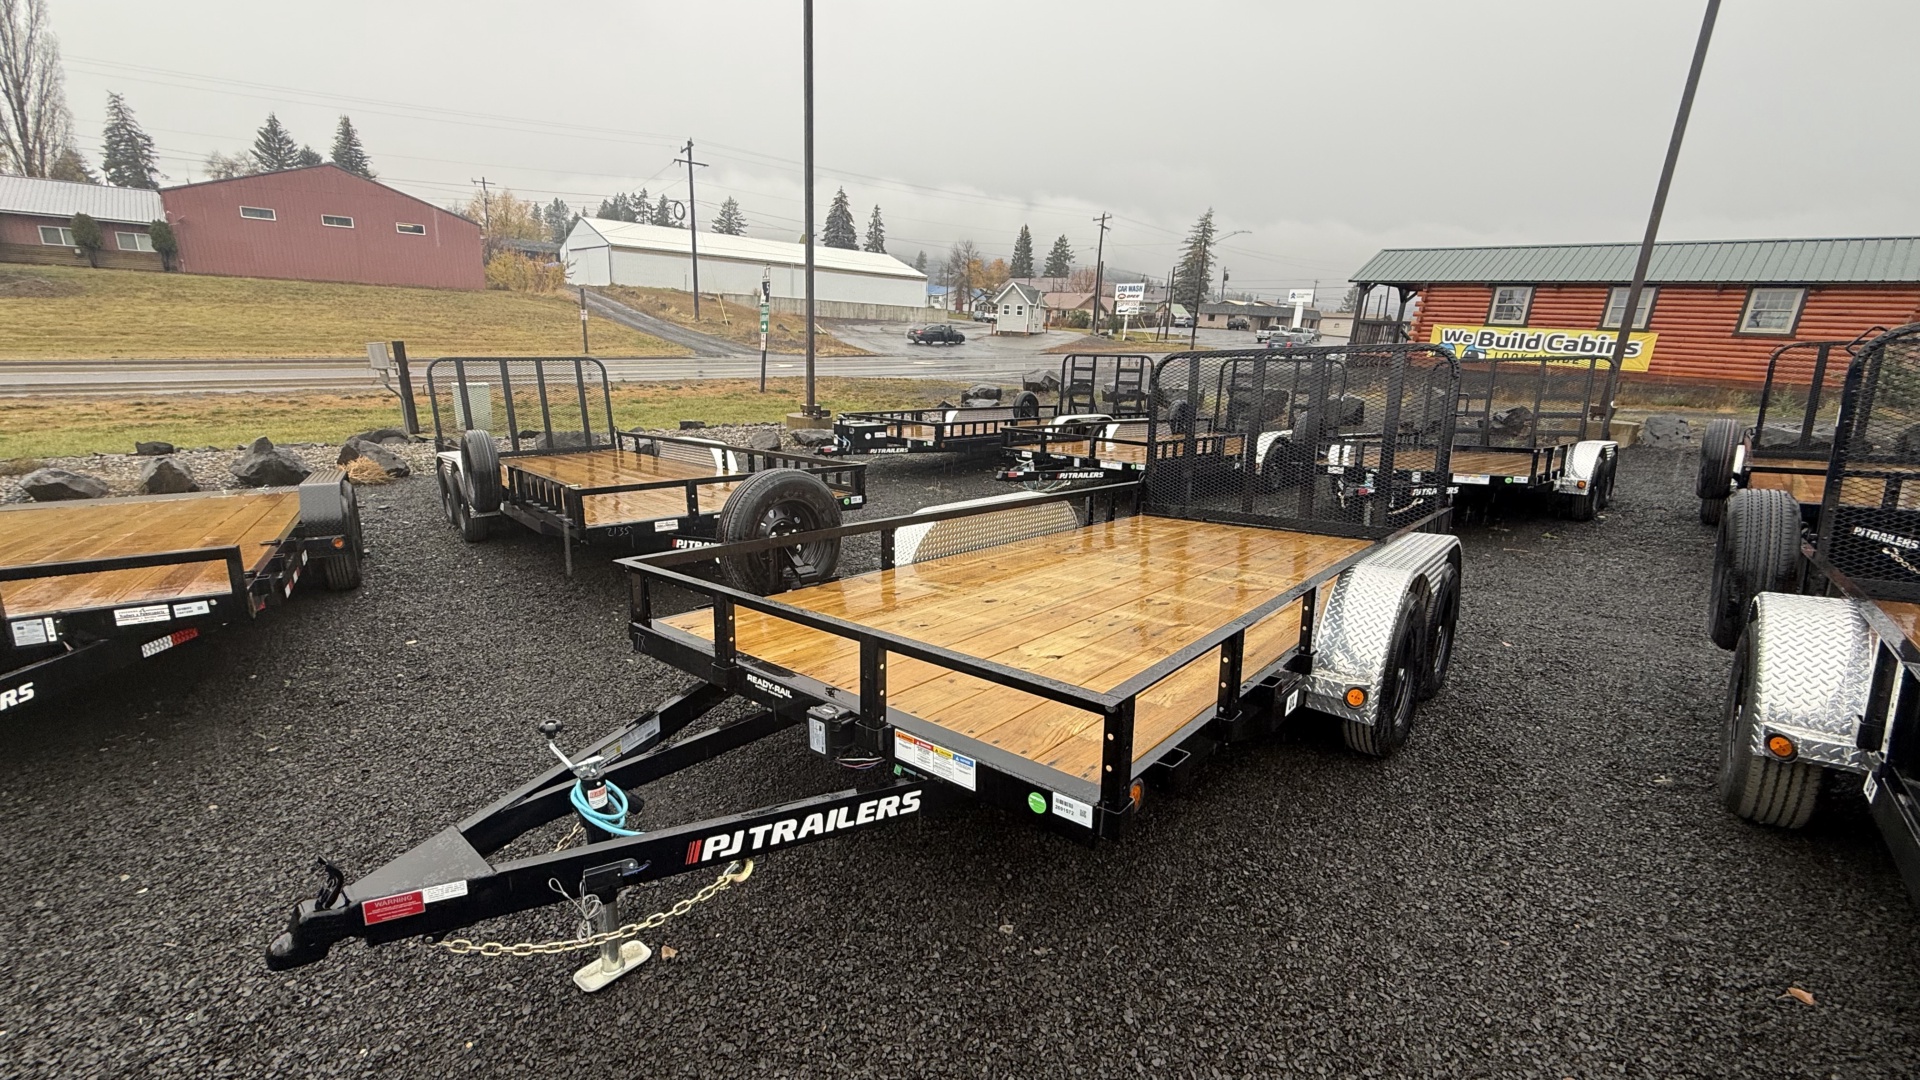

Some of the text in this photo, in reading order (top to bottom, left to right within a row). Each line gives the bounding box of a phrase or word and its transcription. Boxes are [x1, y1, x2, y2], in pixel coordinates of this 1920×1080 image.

[1444, 330, 1473, 344] We
[1477, 331, 1543, 350] Build
[675, 539, 688, 549] PJ
[747, 674, 793, 699] READY-RAIL
[701, 790, 922, 862] PJ TRAILERS
[374, 895, 413, 907] WARNING
